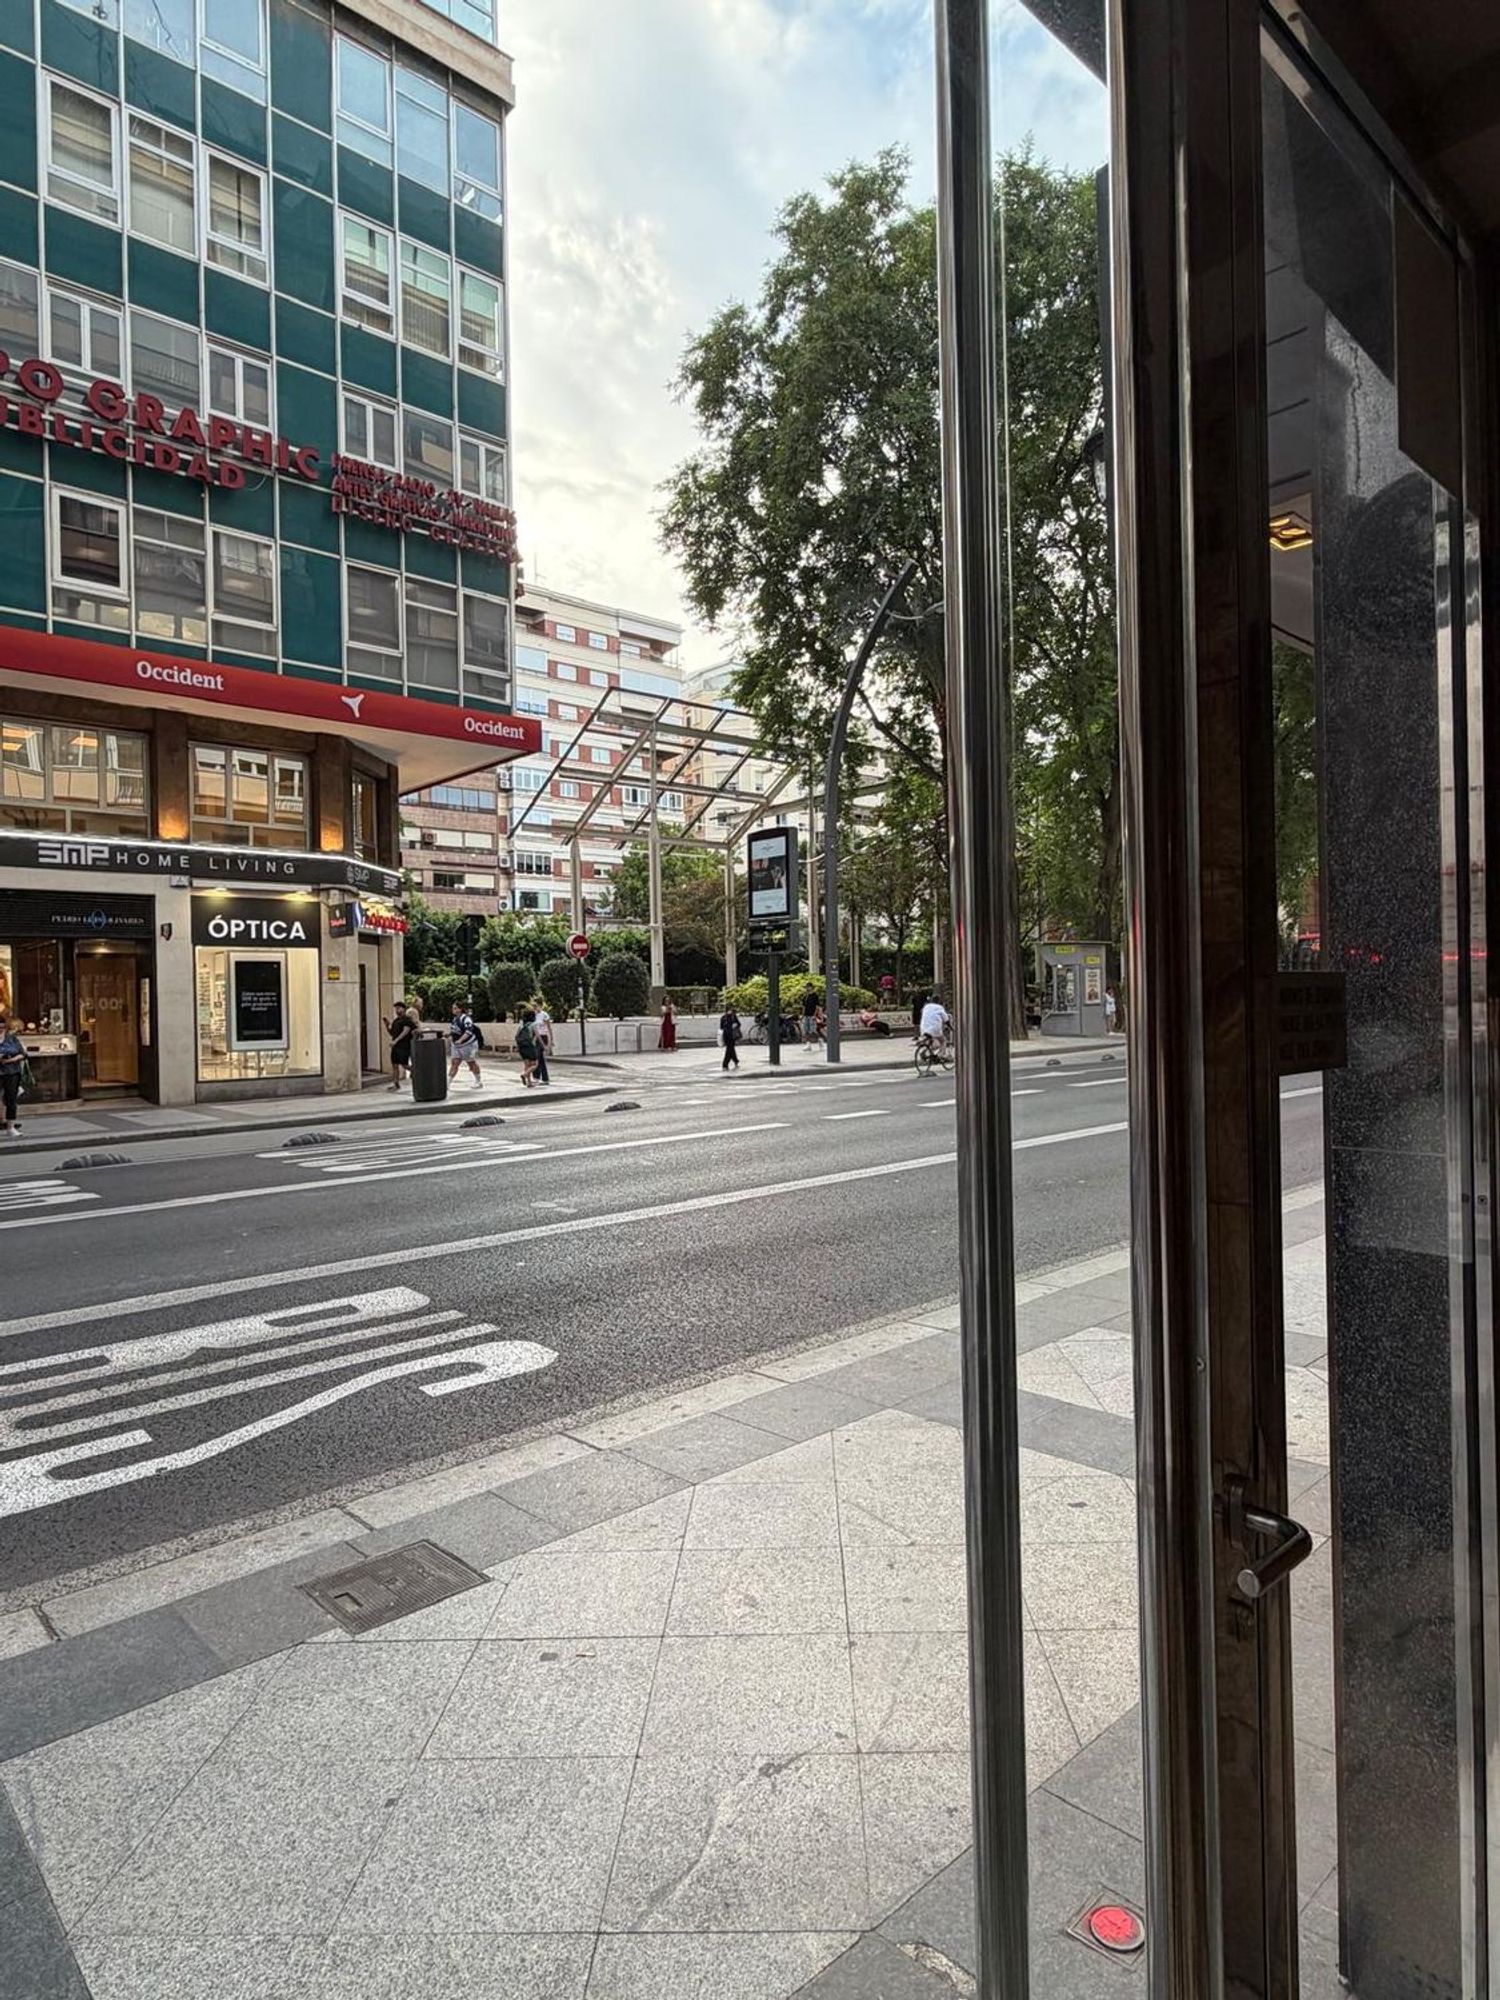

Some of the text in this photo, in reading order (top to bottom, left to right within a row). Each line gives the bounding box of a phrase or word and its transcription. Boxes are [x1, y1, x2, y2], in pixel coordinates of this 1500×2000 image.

[86, 378, 321, 482] GRAPHIC
[136, 660, 225, 692] Occident
[463, 716, 525, 741] Occident
[116, 852, 191, 868] HOME
[209, 858, 296, 875] LIVING
[208, 914, 306, 941] ÓPTICA
